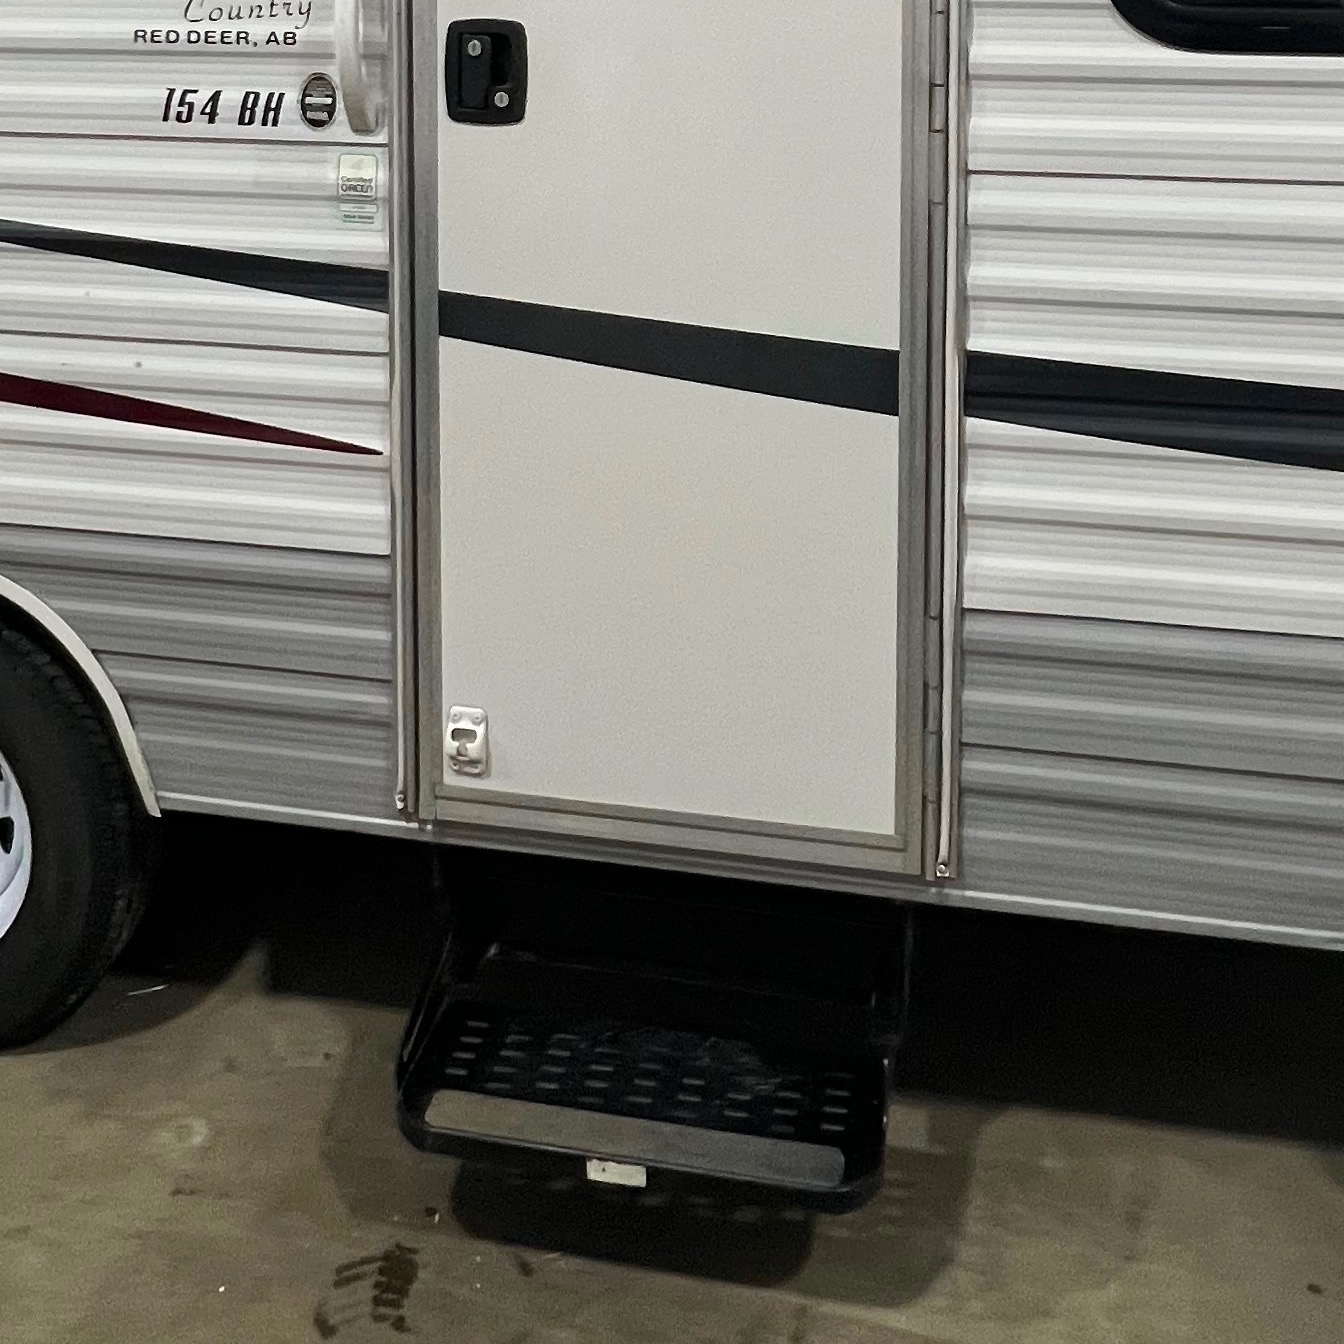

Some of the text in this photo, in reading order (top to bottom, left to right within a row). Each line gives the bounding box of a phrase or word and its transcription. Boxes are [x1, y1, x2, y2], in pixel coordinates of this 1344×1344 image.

[133, 29, 298, 47] RED DEER, AB
[161, 87, 286, 128] 154 BH
